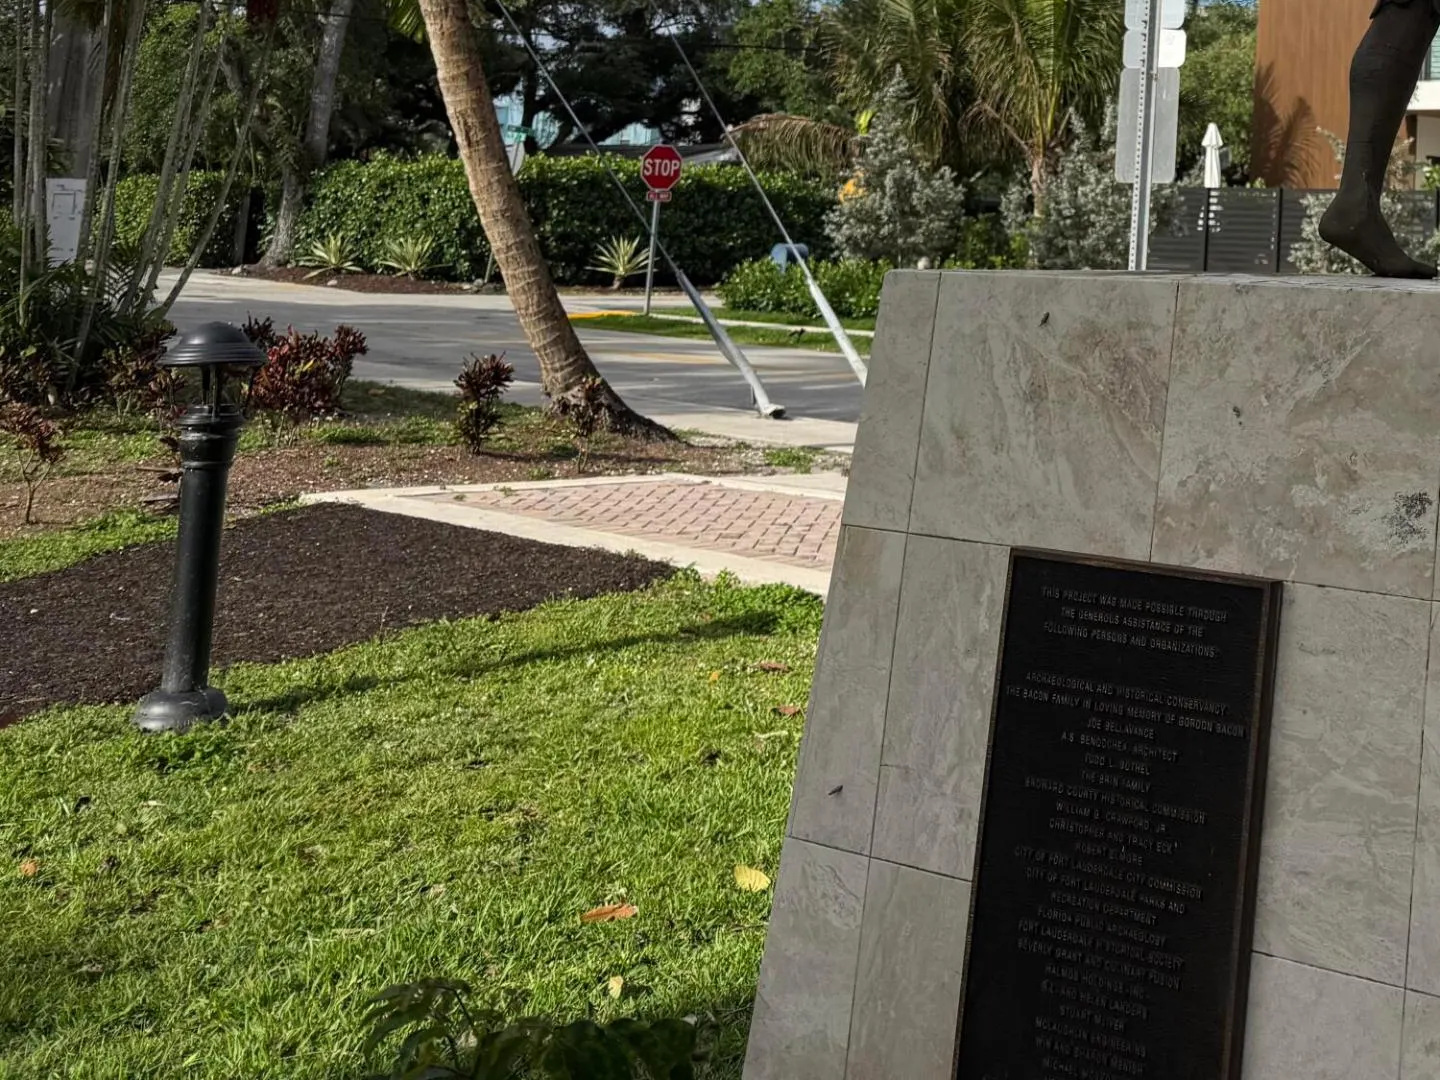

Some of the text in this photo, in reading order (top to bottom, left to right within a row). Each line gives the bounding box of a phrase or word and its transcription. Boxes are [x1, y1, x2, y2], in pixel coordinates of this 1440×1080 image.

[644, 158, 680, 177] STOP
[1041, 585, 1227, 623] THIS PROJECT WAS MADE POSSIBLE THROUGH
[1043, 620, 1088, 638] FOLLOWING
[1090, 627, 1127, 644] PERSONS
[1129, 633, 1146, 647] AND
[1060, 605, 1203, 637] THE GENEROUS ASSISTANCE OF THE
[1025, 669, 1225, 716] ARCHAEOLOGICAL AND HISTORICAL CONSERVANCY
[1005, 685, 1244, 738] THE BACON FAMILY IN LOVING MEMORY OF GORDON BACON
[1086, 716, 1155, 740] JOE BELLAVANCE
[1084, 752, 1105, 767] TODD
[1132, 743, 1177, 762] ARCHITECT
[1080, 769, 1095, 783] THE
[1120, 776, 1150, 794] FAMILY
[1023, 775, 1206, 825] BROWARD COUNTY HISTORICAL COMMISSION
[1055, 799, 1090, 817] WILLIAM
[1048, 816, 1104, 840] CHRISTOPHER
[1106, 829, 1123, 844] AND
[1074, 840, 1105, 858] ROBERT
[1013, 844, 1202, 899] CITY OF FORT LAUDERDALE CITY COMMISSION
[1023, 866, 1185, 915] CITY OF FORT LAUDERDALE PARKS AND
[1049, 890, 1157, 926] RECREATION DEPARTMENT
[1037, 904, 1167, 948] FLORIDA PUBLIC ARCHAEOLOGY
[1017, 918, 1184, 972] FORT LAUDERDALE HISTORICAL SOCIETY
[1084, 953, 1102, 970] AND
